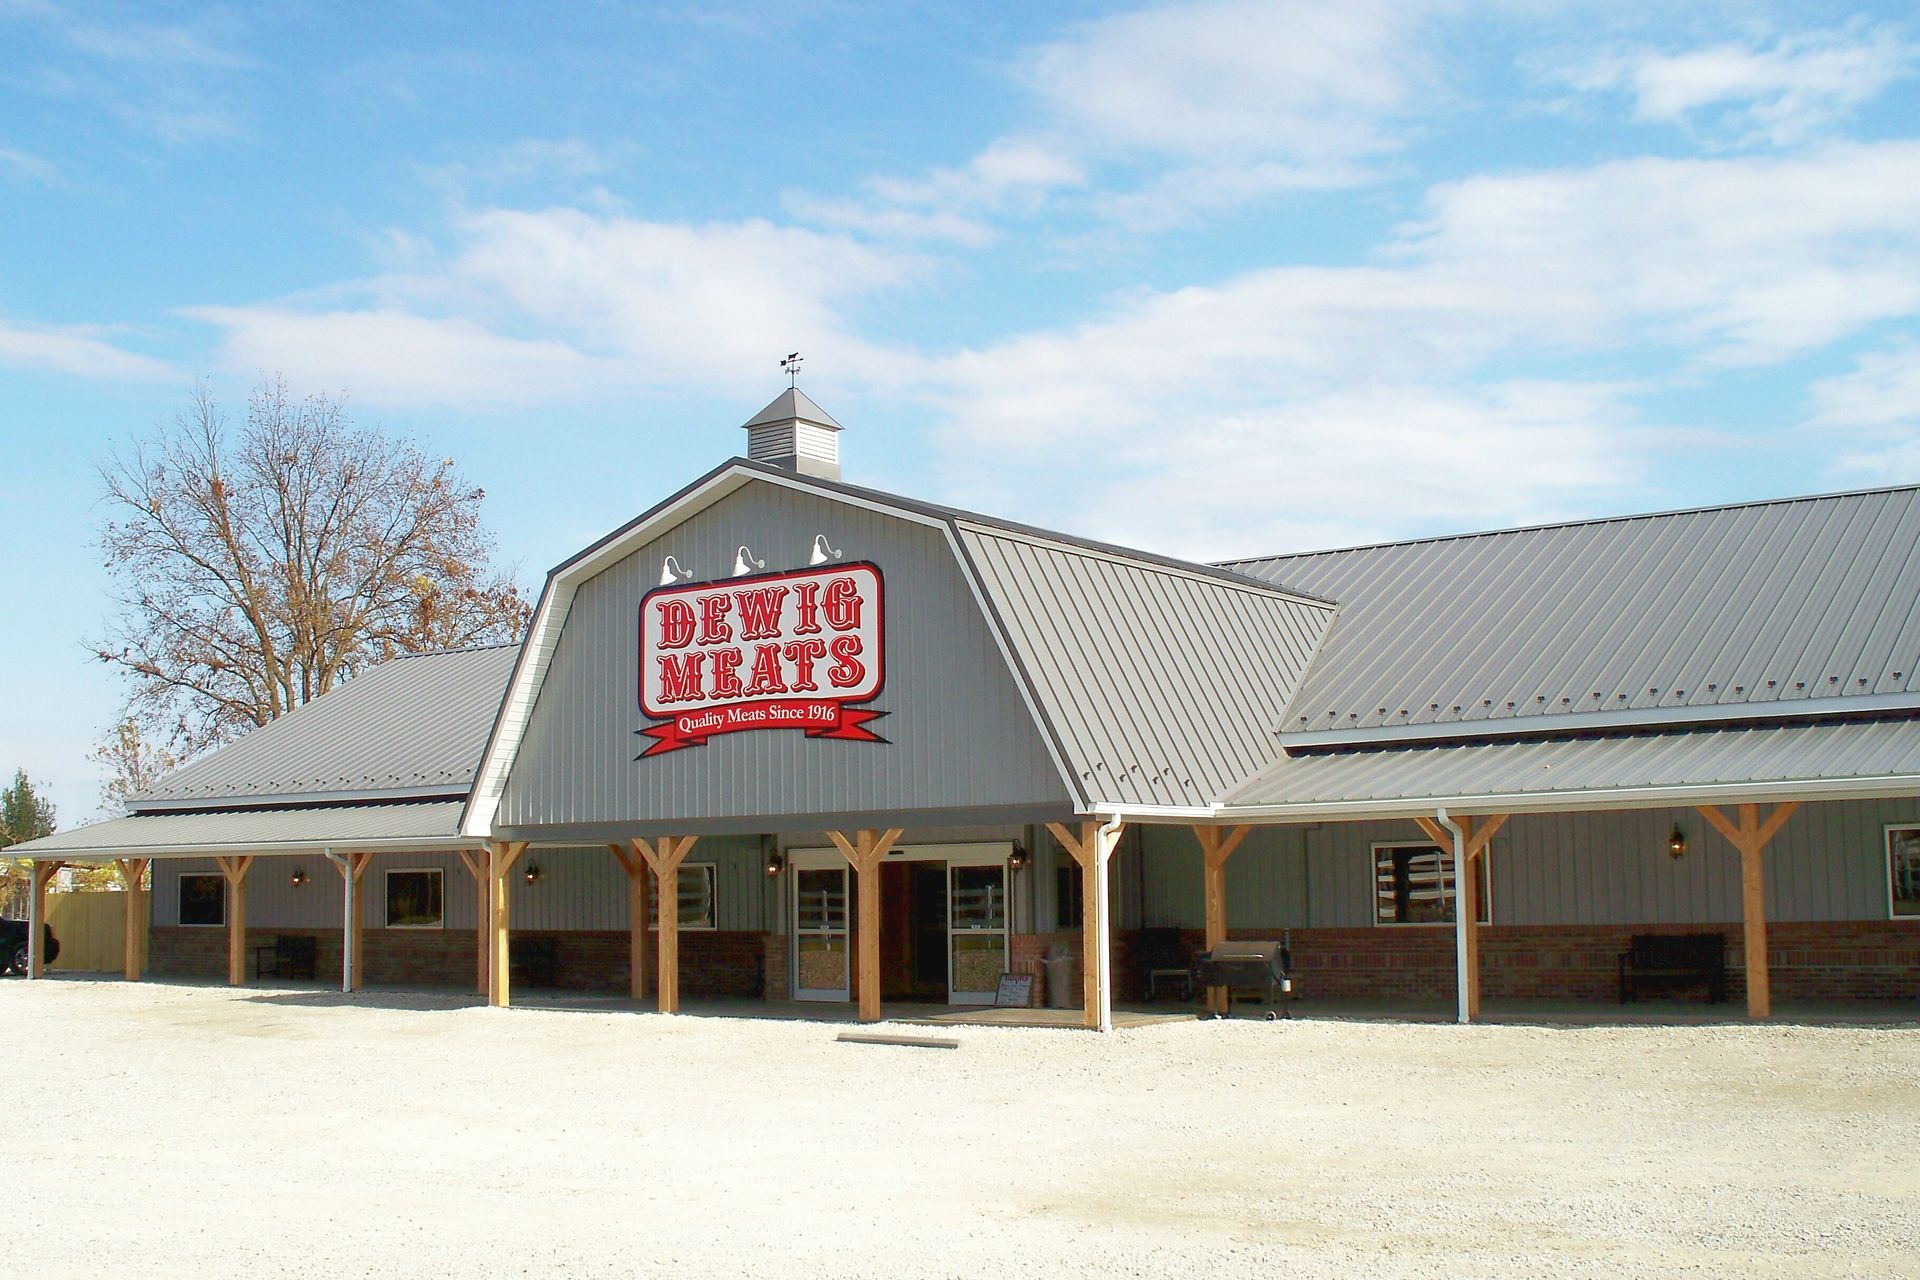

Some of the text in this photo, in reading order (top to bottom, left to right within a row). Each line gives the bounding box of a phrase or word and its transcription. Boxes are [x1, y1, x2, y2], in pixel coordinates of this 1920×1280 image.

[656, 577, 864, 650] DEWIG
[656, 635, 866, 704] MEATS
[679, 705, 835, 733] Quality Meats Since 1916
